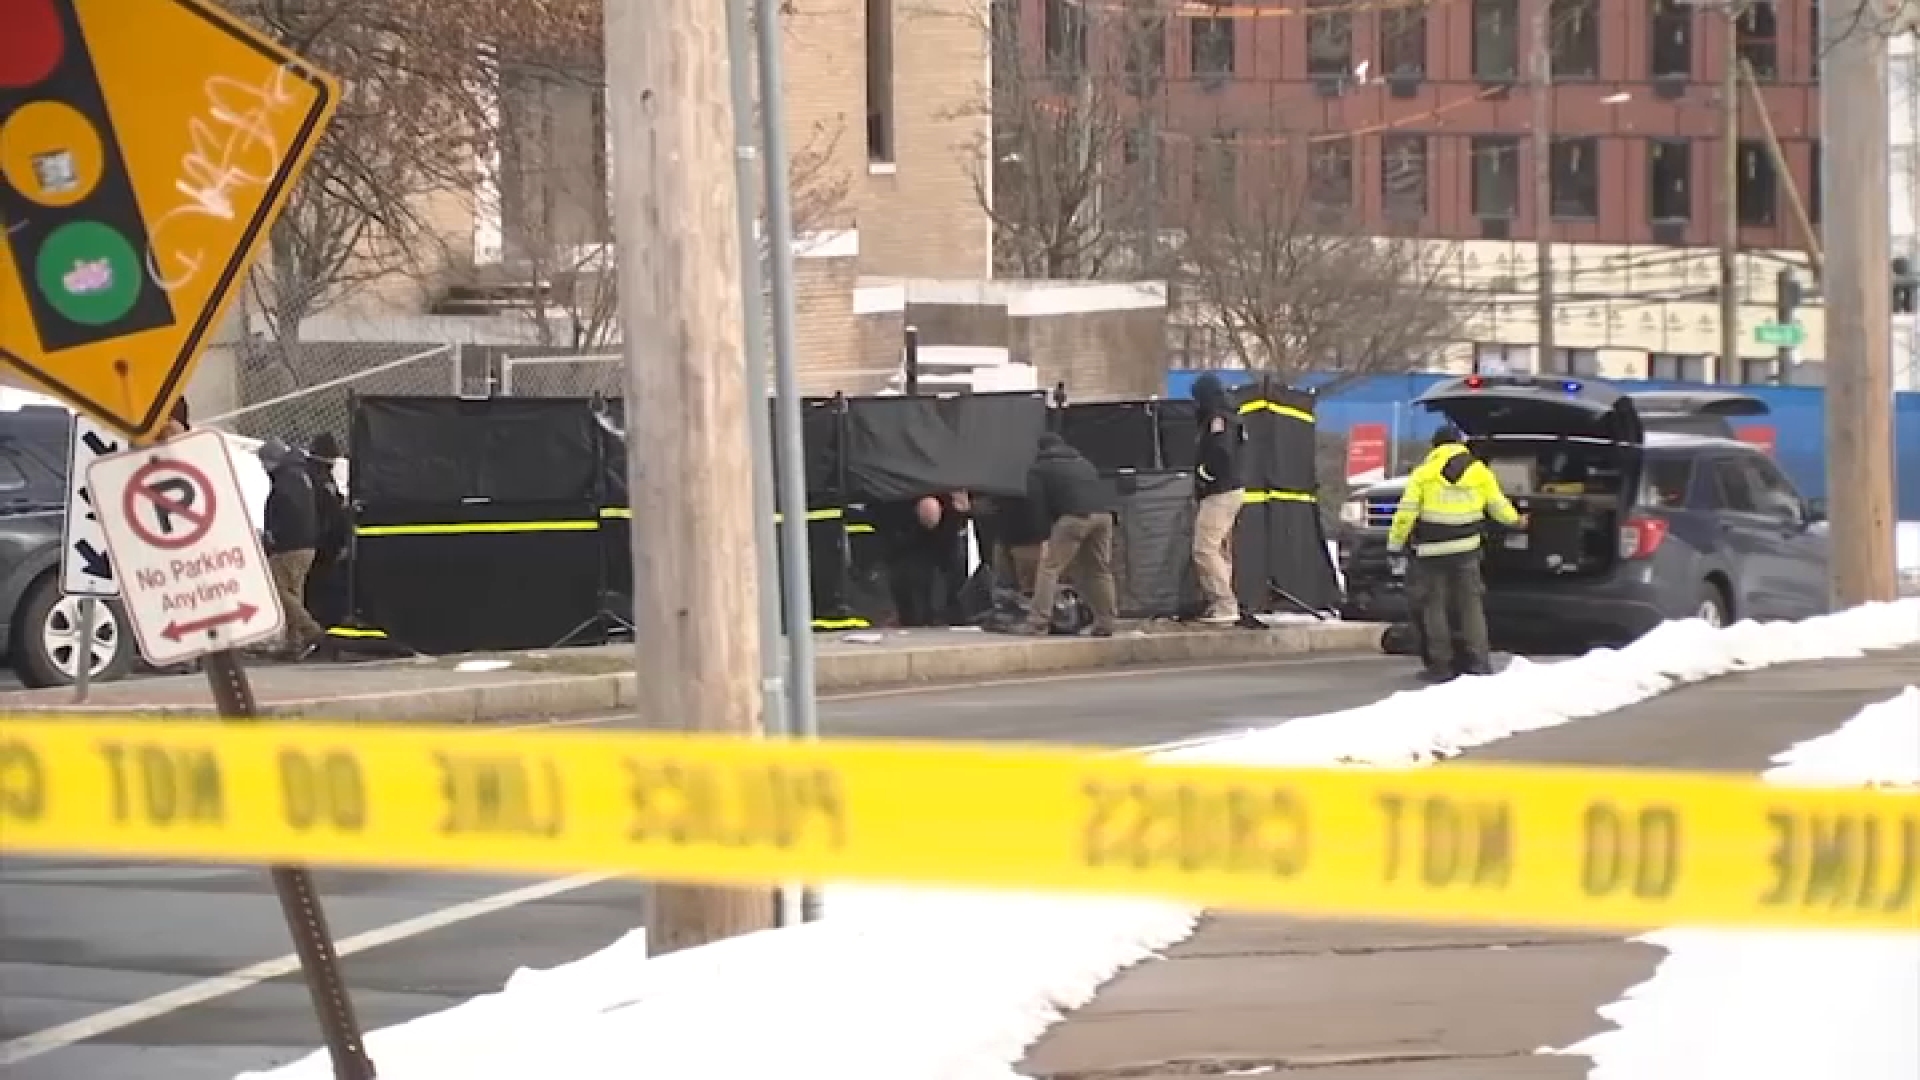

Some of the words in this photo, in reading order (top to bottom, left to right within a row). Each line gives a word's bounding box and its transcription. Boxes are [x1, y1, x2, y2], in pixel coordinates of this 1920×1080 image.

[135, 569, 166, 592] No
[171, 547, 245, 583] Parking
[162, 578, 240, 612] Anytime
